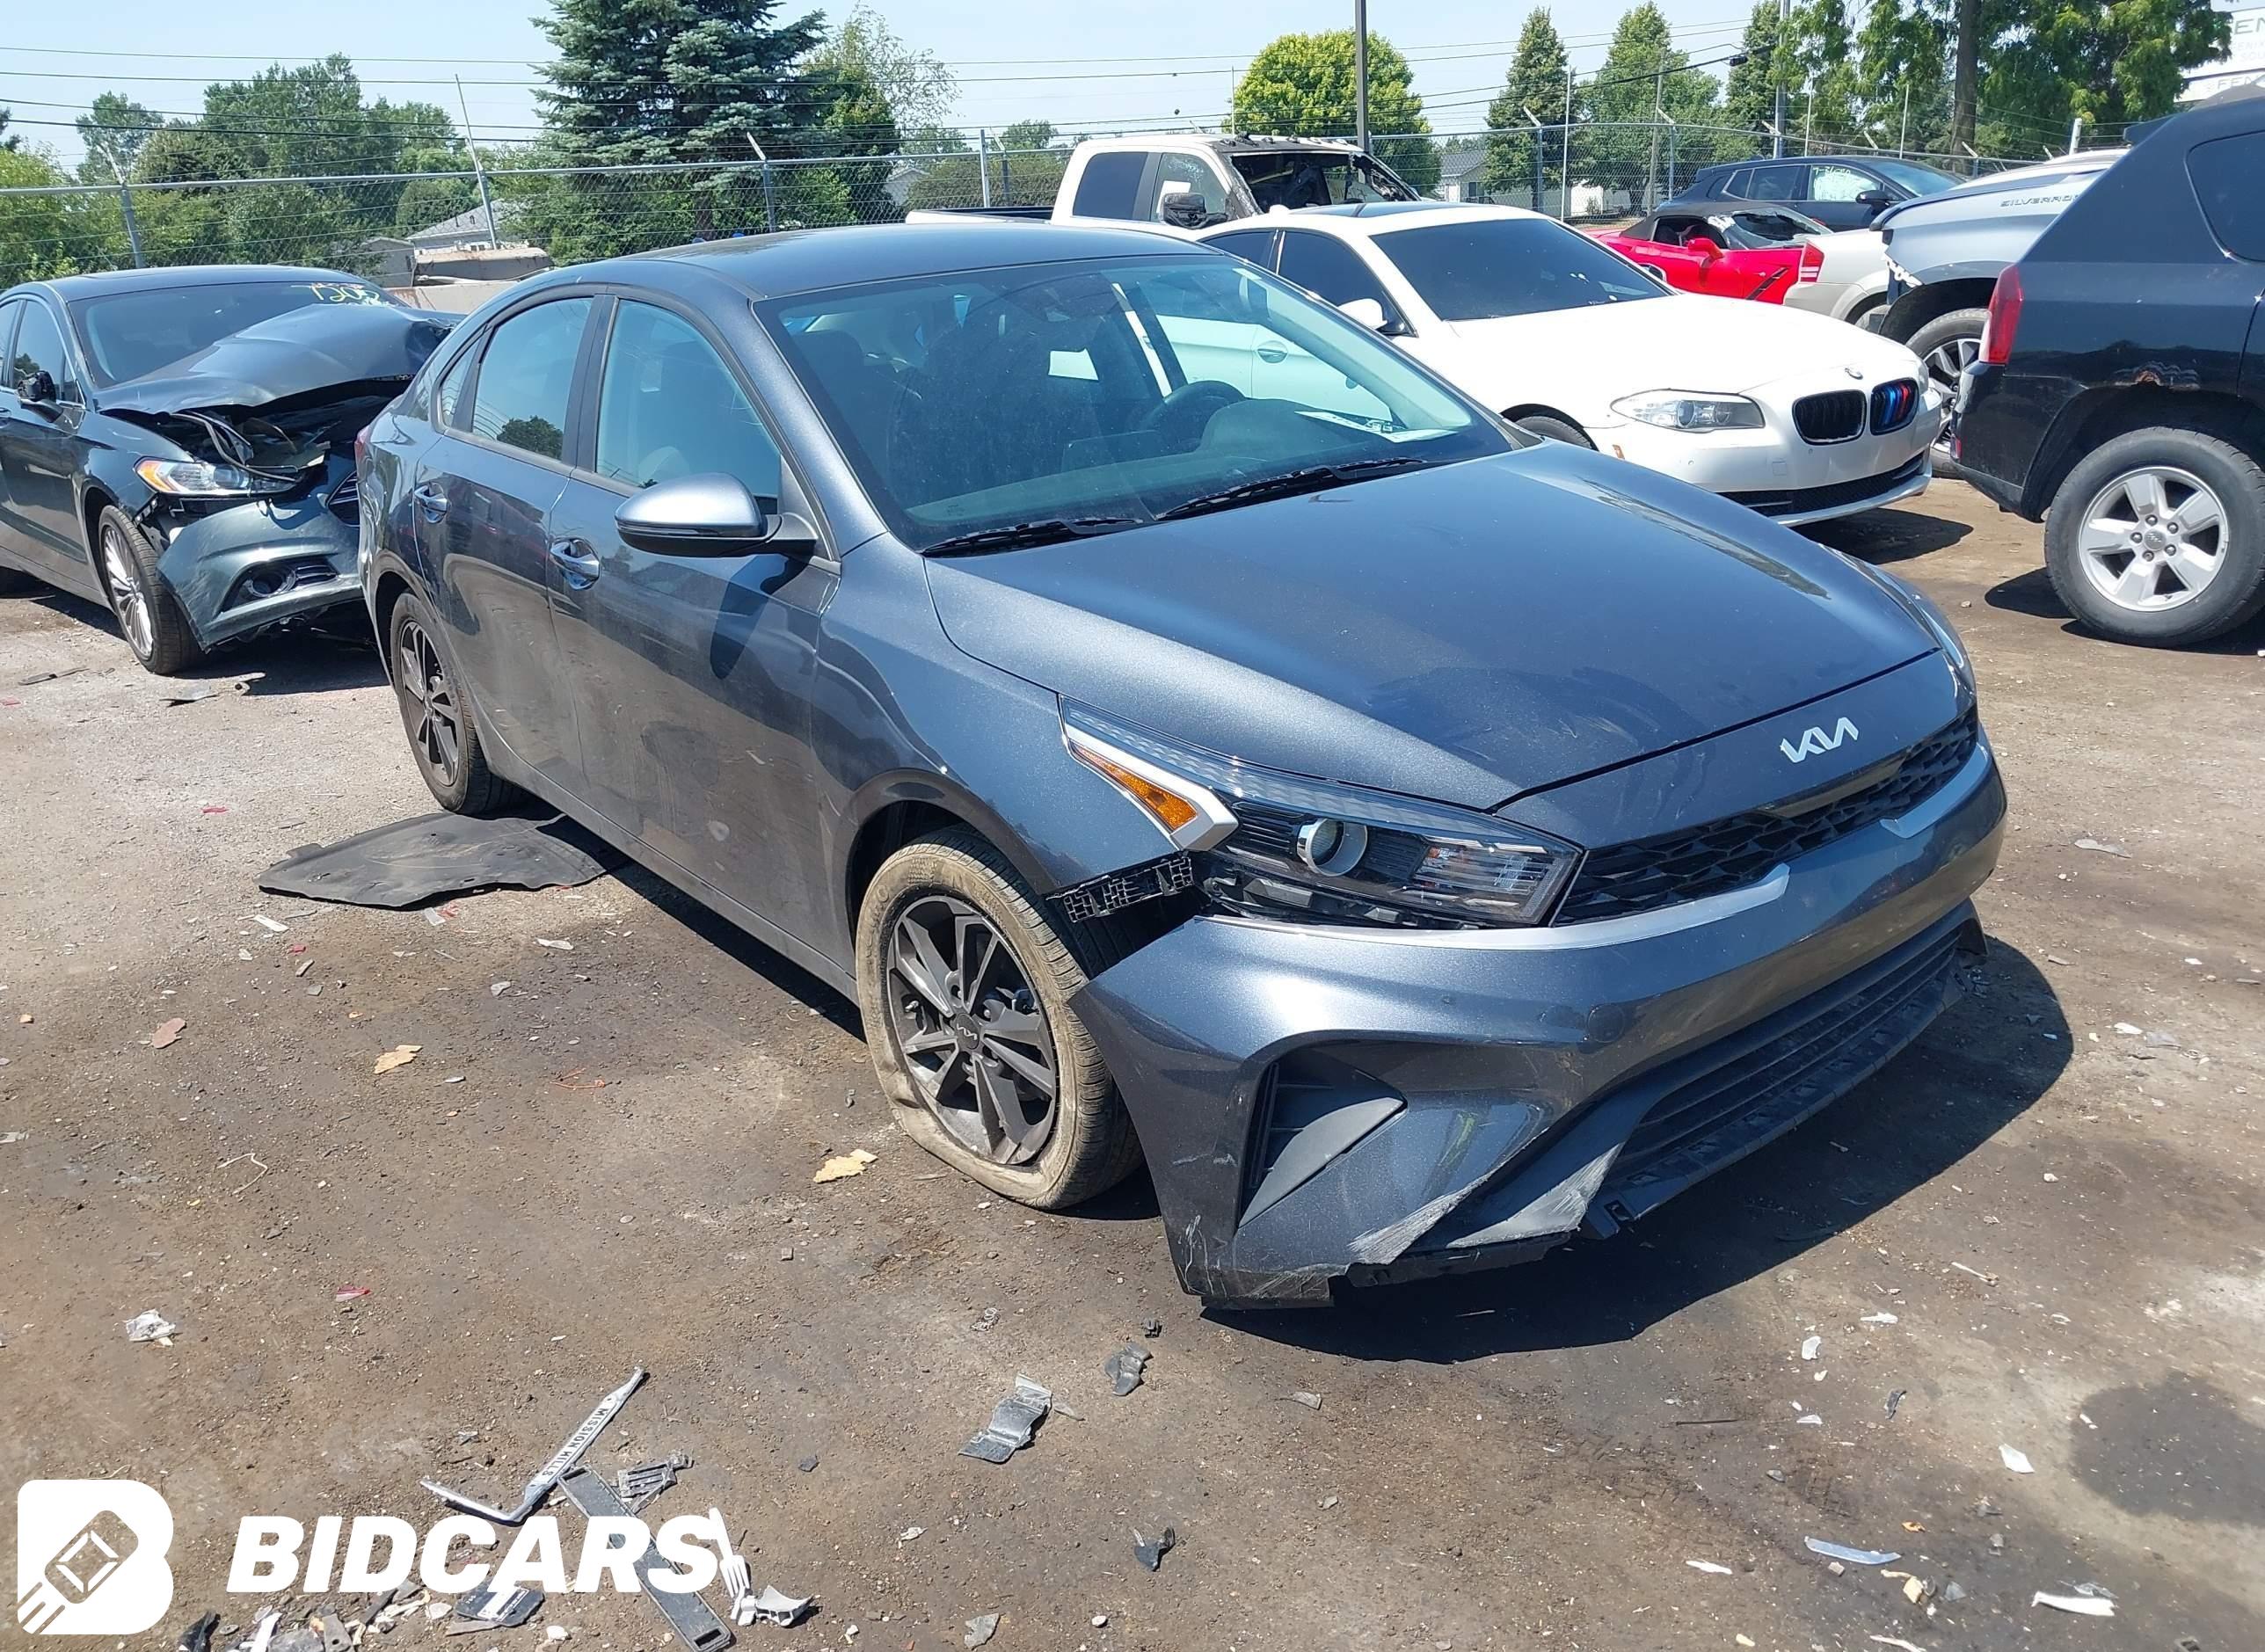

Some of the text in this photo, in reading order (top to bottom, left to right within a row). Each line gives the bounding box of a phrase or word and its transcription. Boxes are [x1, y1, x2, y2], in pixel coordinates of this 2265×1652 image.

[1780, 717, 1859, 763] KIA
[543, 1408, 610, 1476] MISSION HILLS
